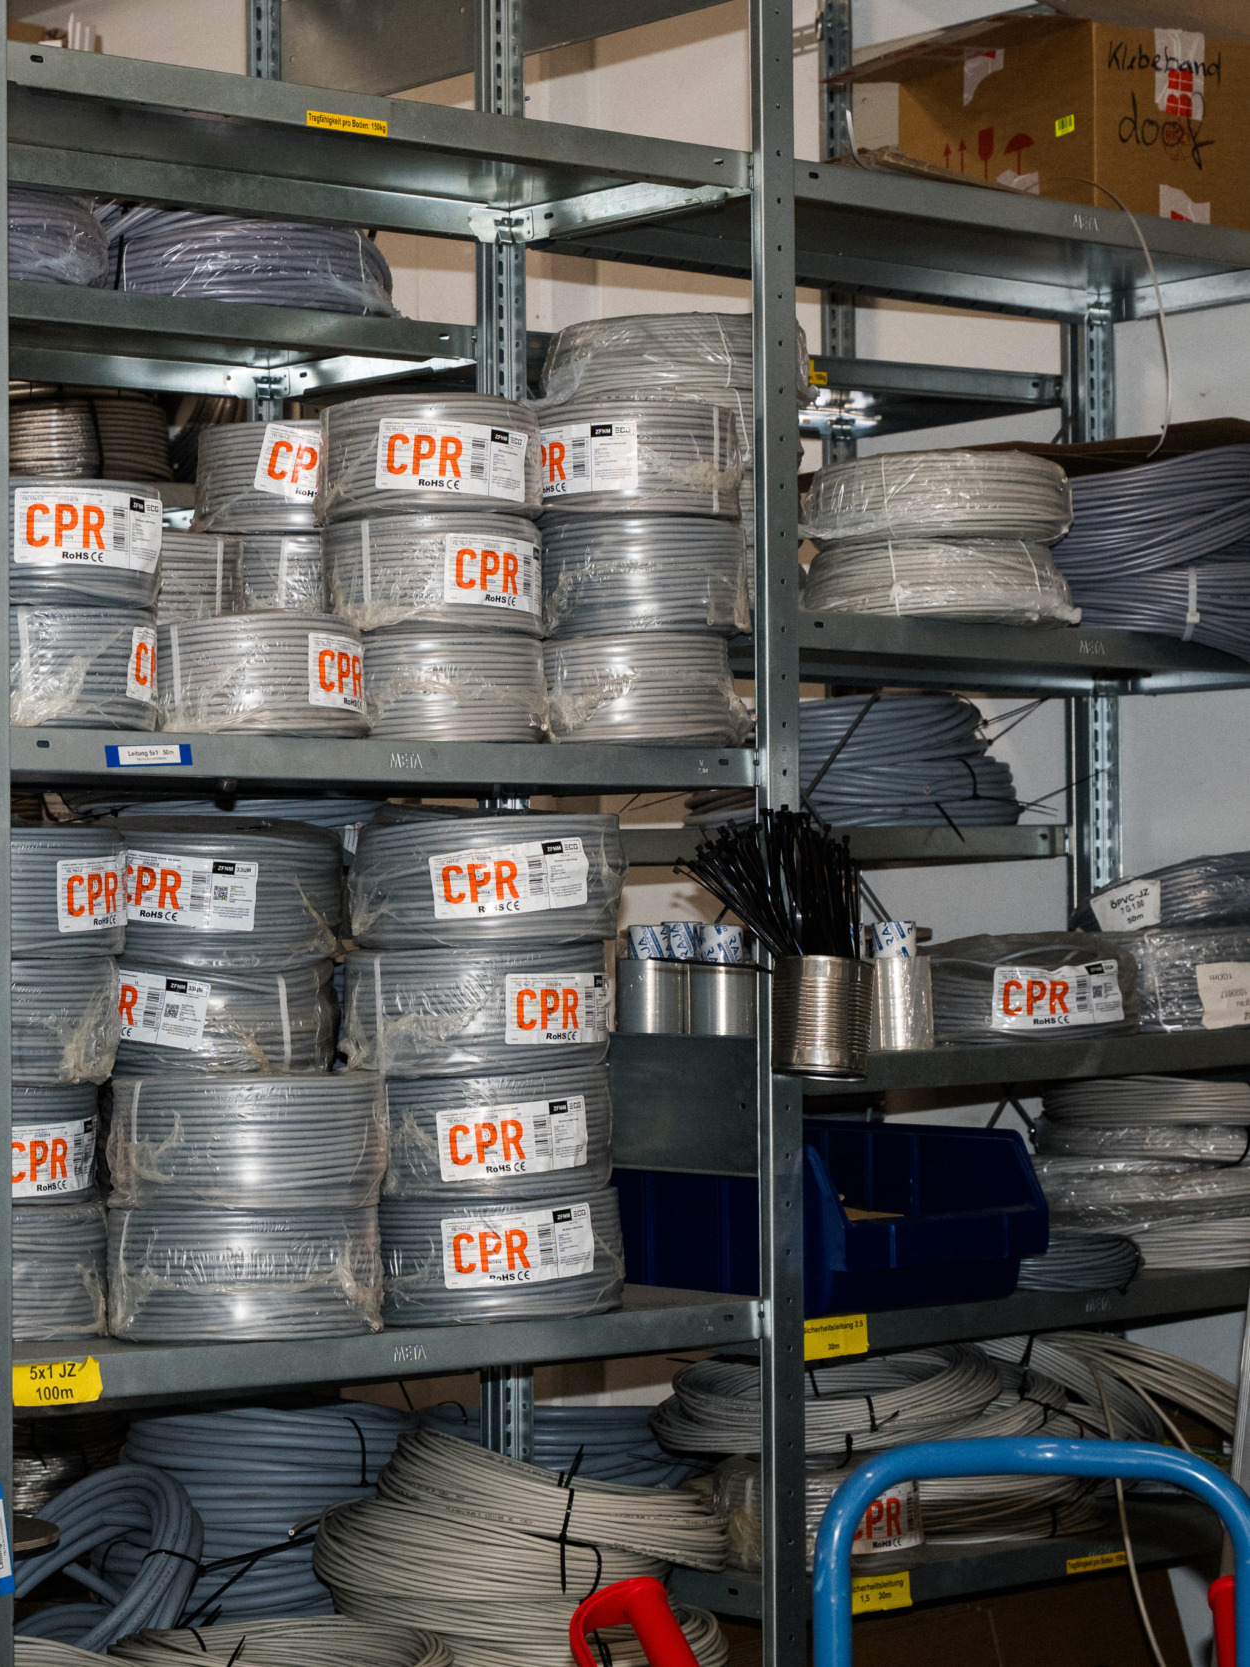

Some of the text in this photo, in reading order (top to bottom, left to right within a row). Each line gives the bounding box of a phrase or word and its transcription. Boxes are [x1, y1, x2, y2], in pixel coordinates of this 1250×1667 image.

[1108, 41, 1220, 88] Klebeband
[341, 119, 351, 128] pro
[267, 440, 318, 488] CP
[386, 433, 463, 478] CPR
[418, 478, 444, 487] RoHS
[25, 503, 106, 550] CPR
[62, 551, 89, 560] RoHS
[455, 548, 519, 596] CPR
[484, 593, 507, 604] RoHS
[134, 641, 157, 689] C
[318, 648, 363, 699] CPR
[66, 871, 118, 917] CPR
[441, 859, 520, 905] CPR
[139, 909, 163, 920] RoHS
[516, 988, 579, 1031] CPR
[1002, 979, 1070, 1017] CPR
[545, 1032, 567, 1040] RoHS
[1033, 1017, 1057, 1025] RoHS
[11, 1138, 68, 1183] CPR
[448, 1119, 527, 1167] CPR
[36, 1182, 57, 1192] RoHS
[485, 1163, 512, 1174] RoHS
[452, 1229, 531, 1274] CPR
[29, 1363, 77, 1381] 5x1 JZ
[36, 1386, 74, 1401] 100m
[853, 1497, 903, 1541] PR
[878, 1590, 892, 1601] 30m
